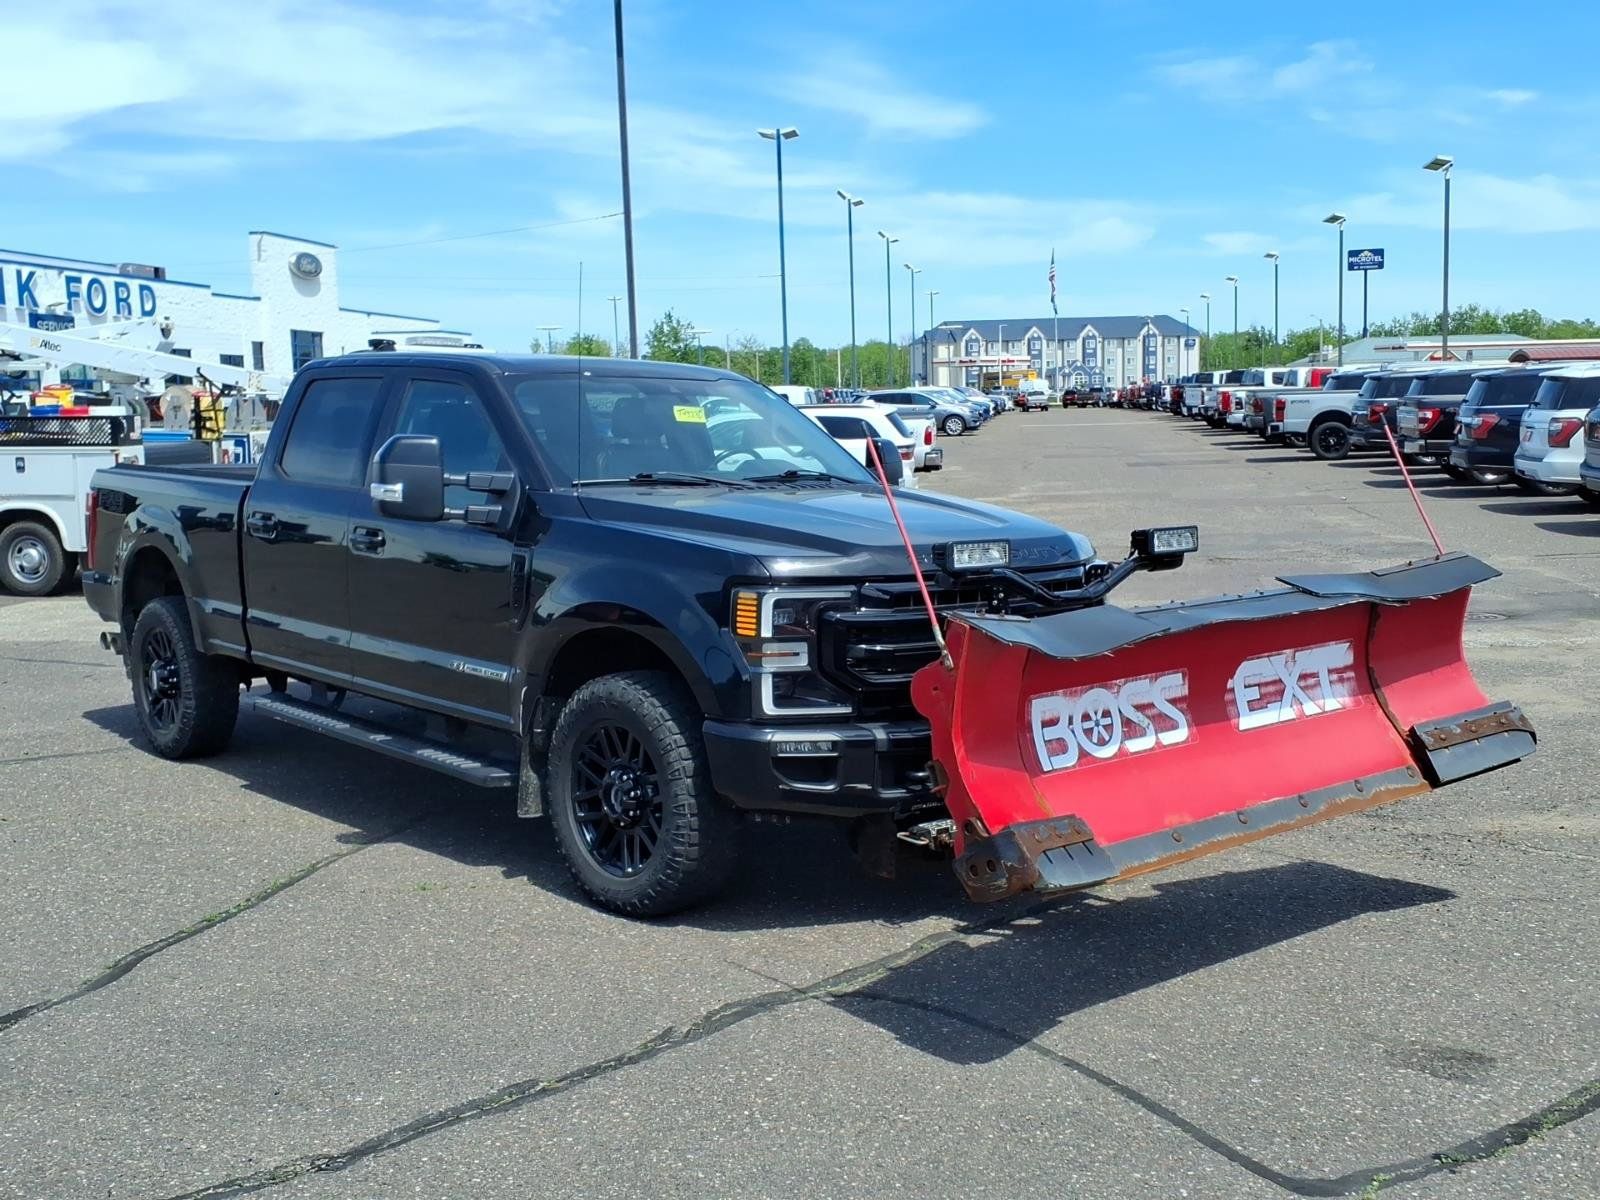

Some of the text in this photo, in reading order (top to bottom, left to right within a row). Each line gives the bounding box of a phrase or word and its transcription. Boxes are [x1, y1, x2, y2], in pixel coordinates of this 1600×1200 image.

[1348, 255, 1383, 263] MICROTEL
[65, 275, 156, 317] FORD
[40, 339, 62, 352] Altec
[1031, 642, 1353, 772] BOSS EXT
